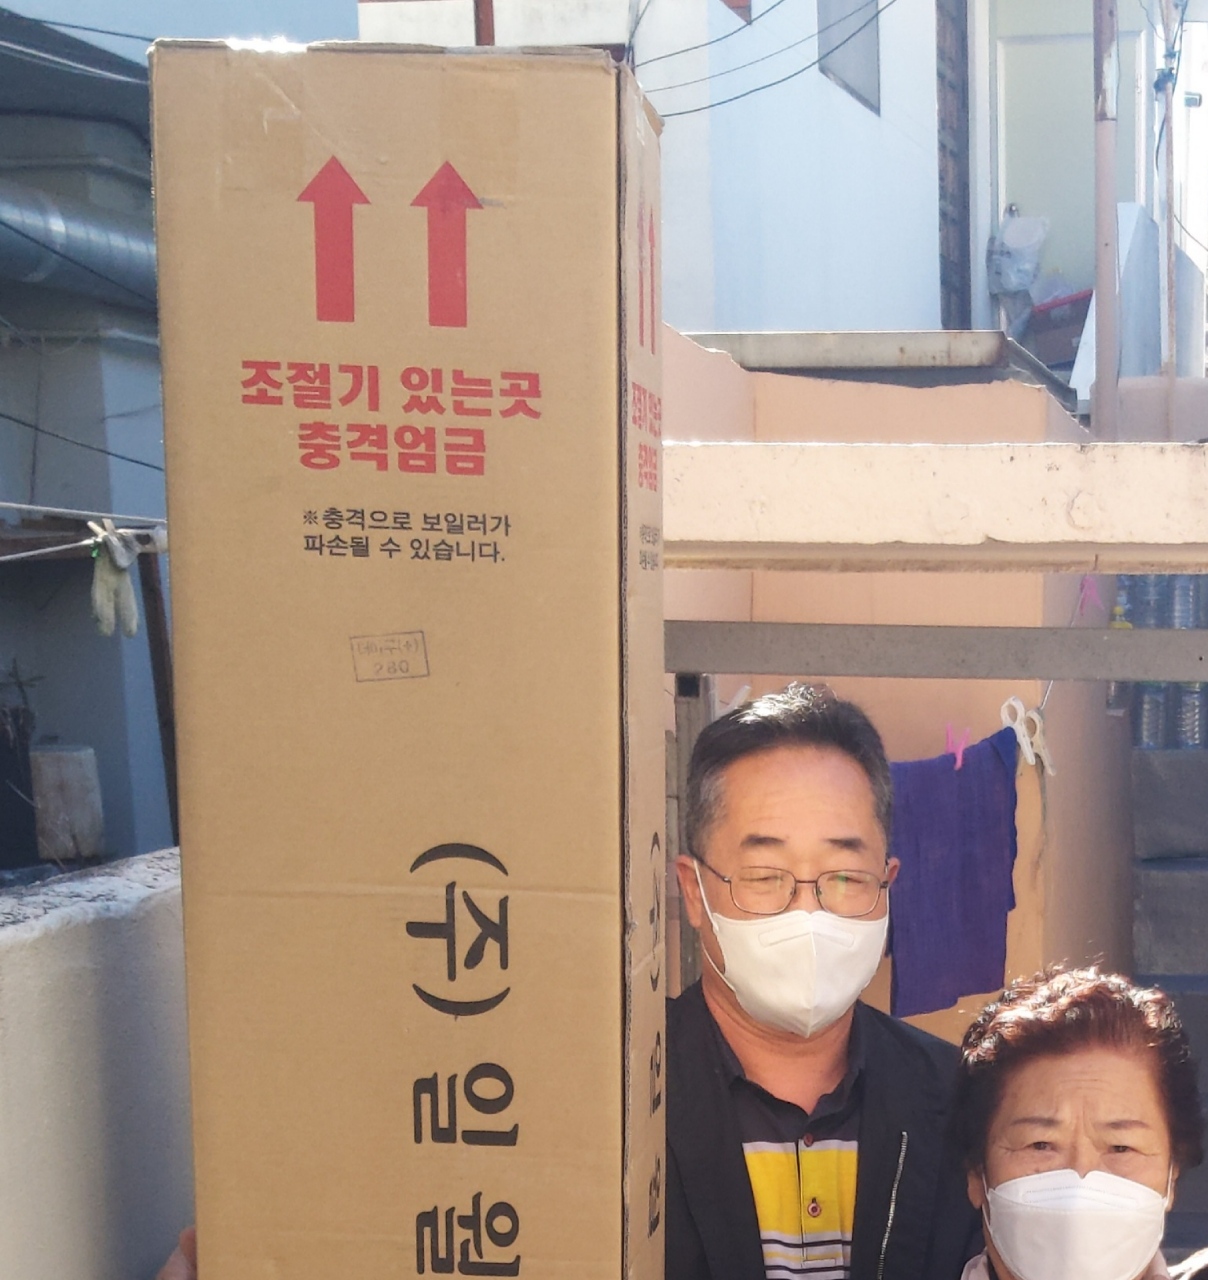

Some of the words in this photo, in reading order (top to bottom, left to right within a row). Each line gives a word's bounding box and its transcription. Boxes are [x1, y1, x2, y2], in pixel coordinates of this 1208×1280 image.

[239, 359, 381, 412] 조절기
[398, 365, 542, 420] 있는곳
[296, 421, 487, 476] 충격엄금
[421, 510, 512, 536] 보일러가
[303, 534, 372, 559] 파손될
[379, 537, 402, 560] 수
[409, 537, 506, 563] 있습니다.
